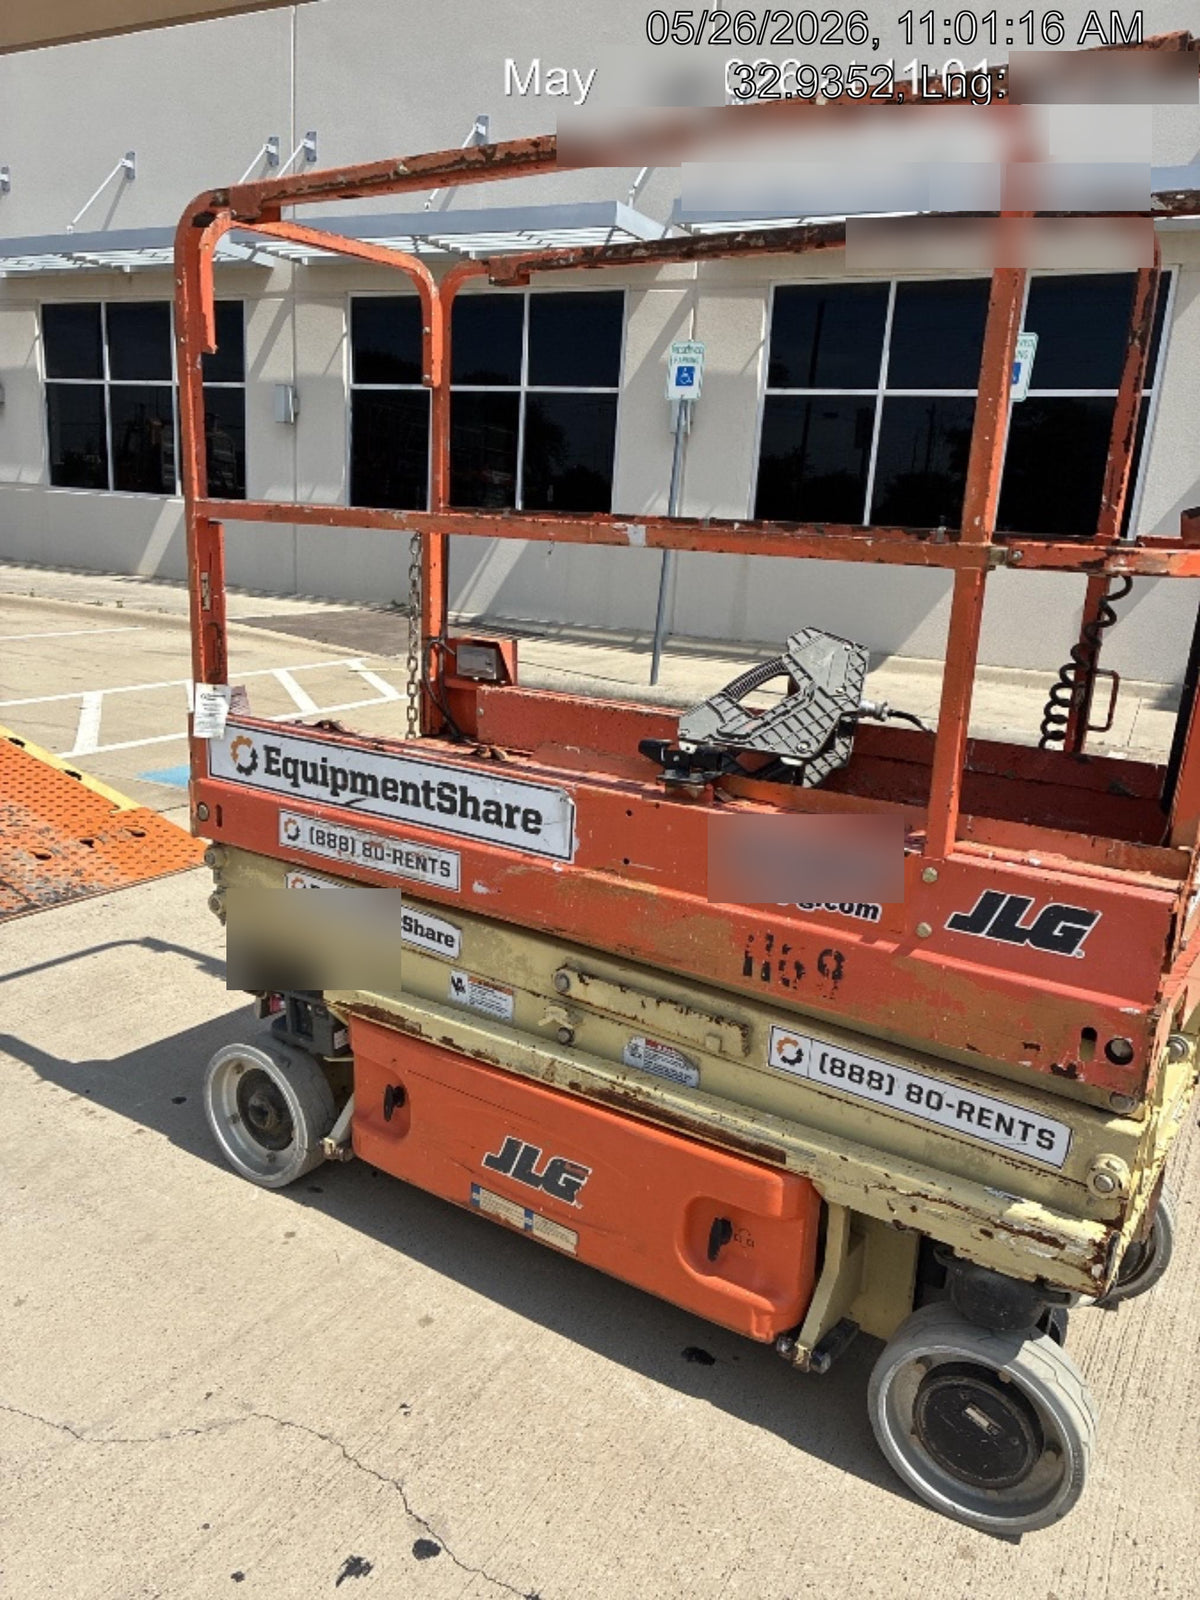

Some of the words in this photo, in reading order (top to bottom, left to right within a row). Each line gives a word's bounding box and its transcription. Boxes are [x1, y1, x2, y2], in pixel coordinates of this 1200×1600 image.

[262, 744, 543, 836] EquipmentShare
[308, 824, 357, 857] (888)
[361, 840, 451, 878] 80-RENTS
[401, 914, 455, 948] Share
[945, 889, 1102, 957] JLG
[818, 1052, 896, 1096] (888)
[904, 1082, 1056, 1151] 80-RENTS
[481, 1136, 593, 1206] JLG
